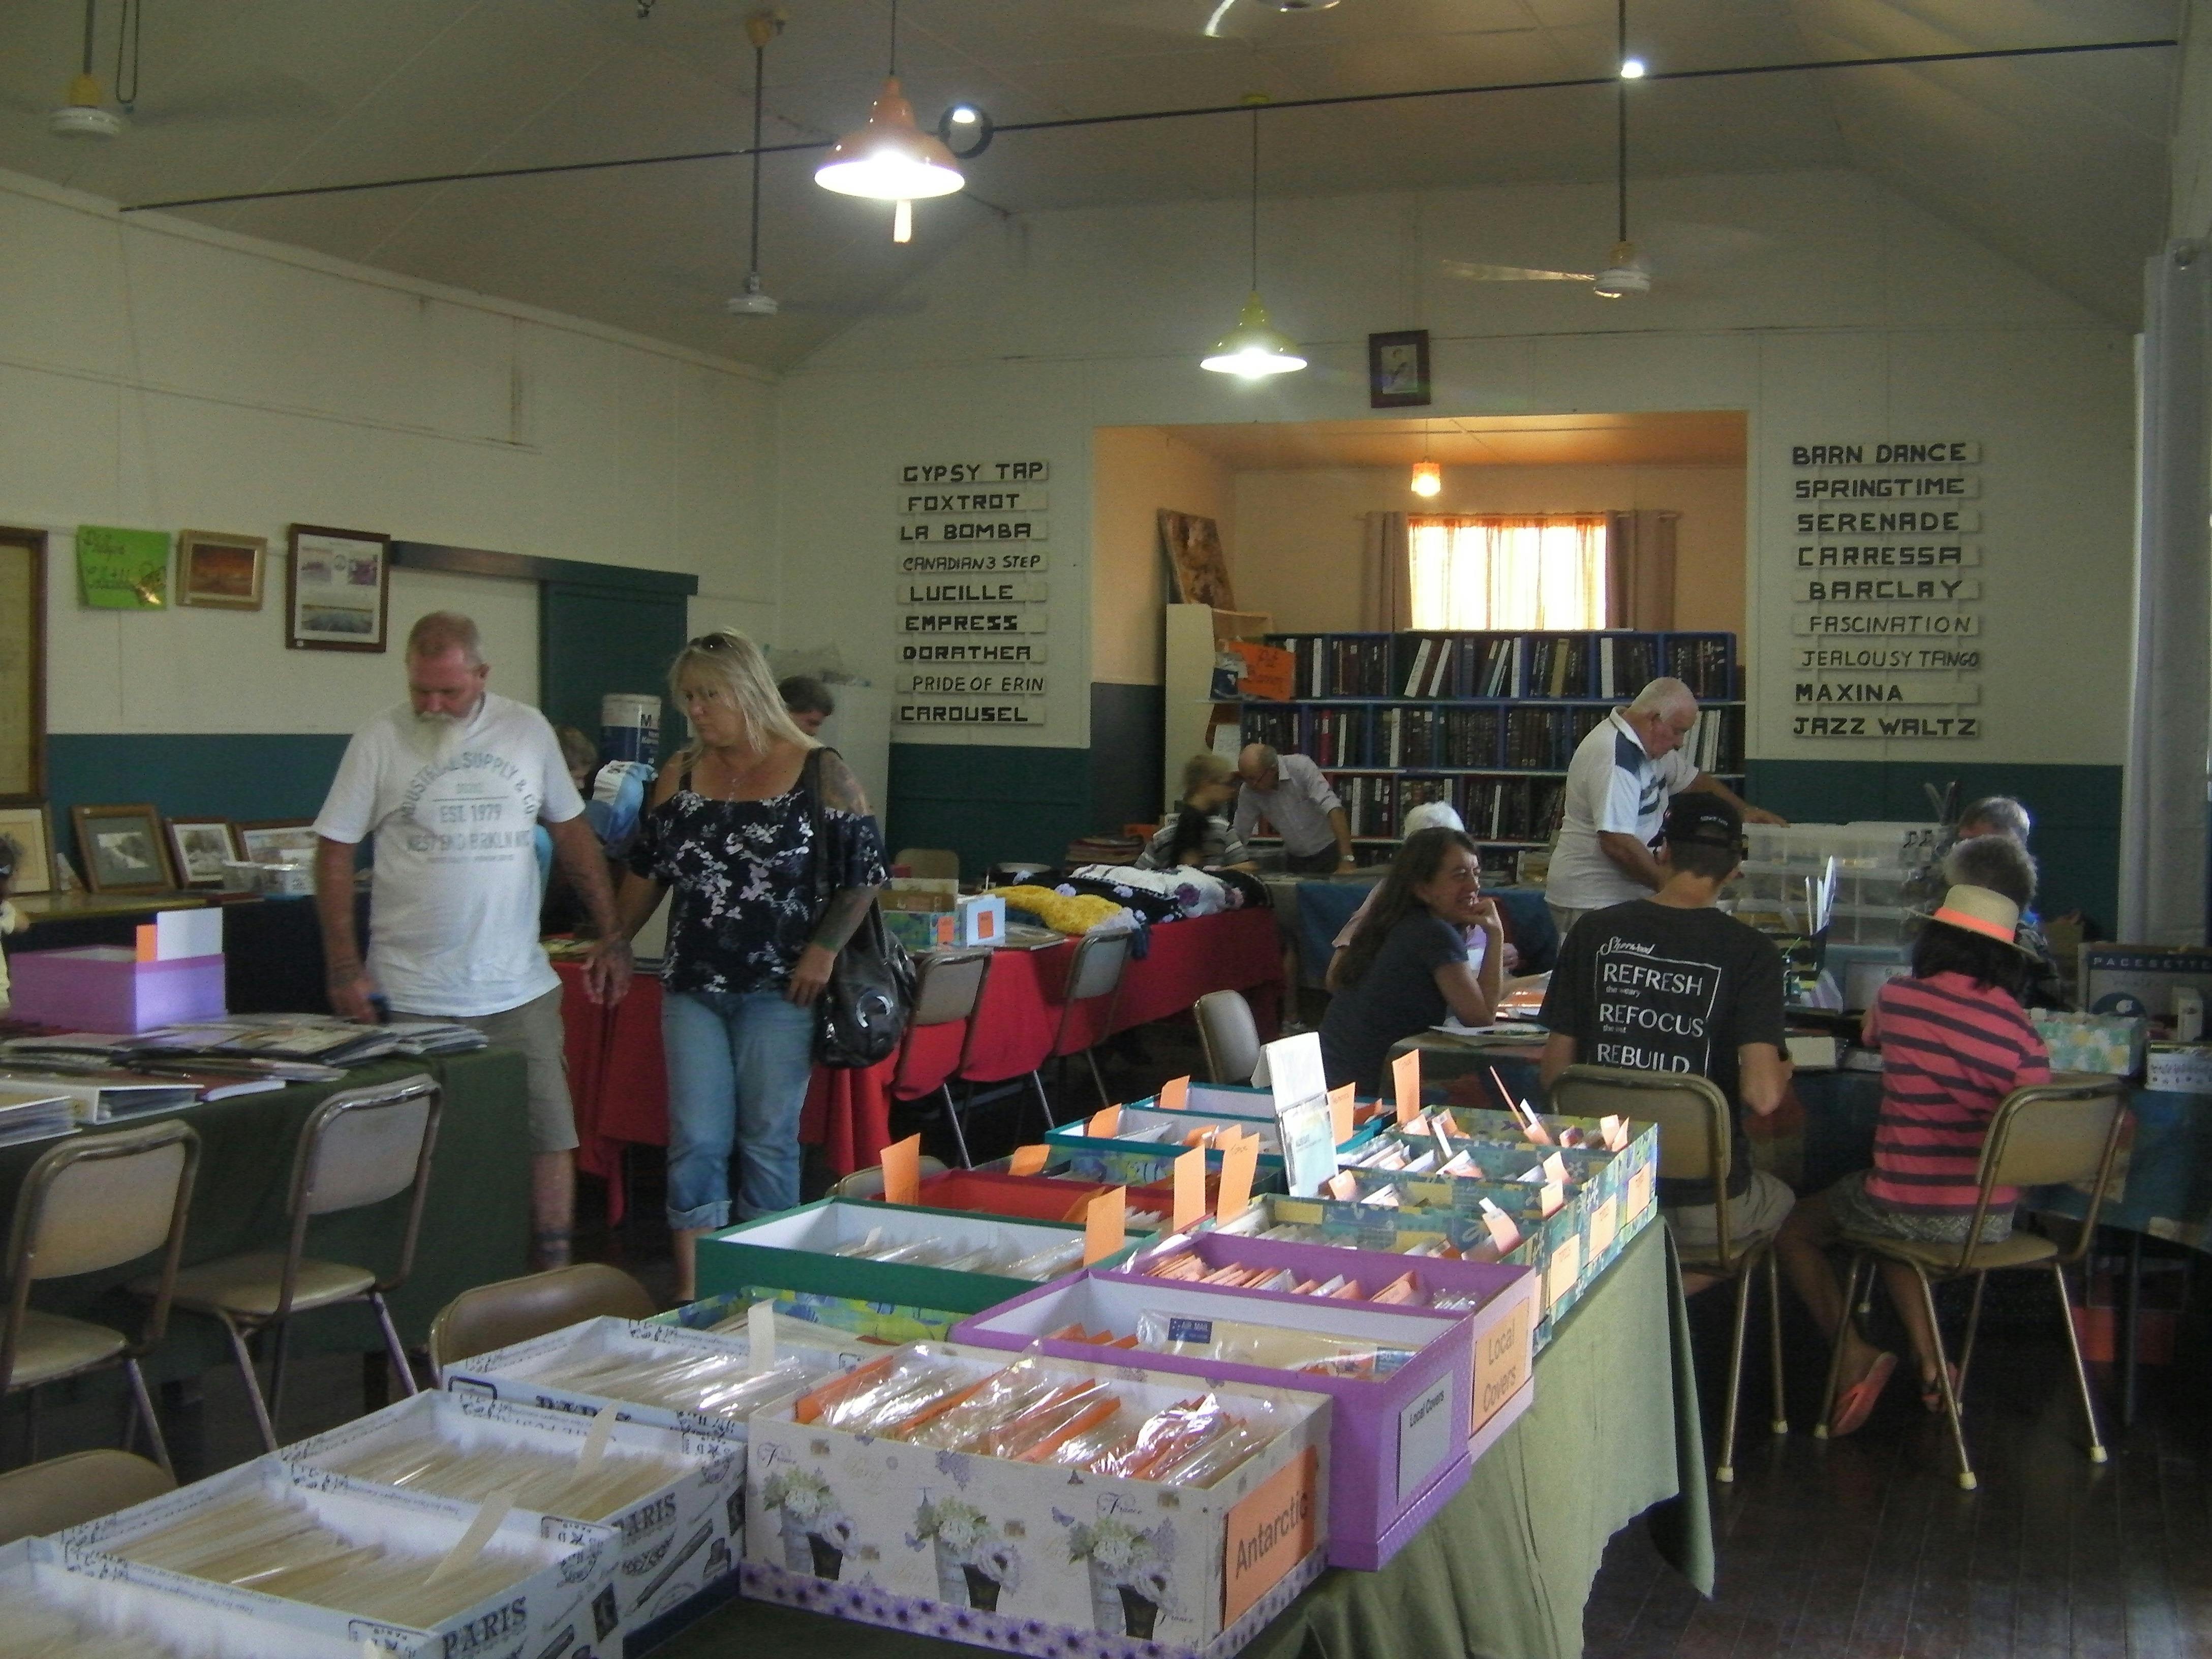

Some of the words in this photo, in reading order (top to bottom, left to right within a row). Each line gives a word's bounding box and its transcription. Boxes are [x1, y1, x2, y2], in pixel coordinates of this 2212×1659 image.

[1792, 445, 1863, 465] BARN
[1876, 443, 1966, 463] DANCE
[903, 464, 980, 482] GYPSY
[995, 462, 1043, 479] TAP
[1795, 478, 1964, 499] SPRINGTIME
[908, 493, 1020, 511] FOXTROT
[900, 525, 929, 541] LA
[944, 523, 1031, 540] BOMBA
[1798, 512, 1959, 532] SERENADE
[903, 556, 984, 571] CANADIAN
[1002, 554, 1041, 568] STEP
[1798, 546, 1962, 566] CARRESSA
[910, 585, 1013, 601] LUCILLE
[1809, 580, 1962, 600] BARCLAY
[905, 615, 1018, 631] EMPRESS
[1809, 616, 1970, 633] FASCINATION
[903, 646, 1031, 661] DORATHEA
[1802, 650, 1913, 667] JEALOUSY
[1919, 651, 1980, 668] TANGO
[913, 675, 966, 692] PRIDE
[970, 677, 992, 691] OF
[1002, 677, 1043, 691] ERIN
[1795, 684, 1903, 702] MAXINA
[901, 705, 1028, 722] CAROUSEL
[1793, 717, 1865, 735] JAZZ
[1879, 717, 1976, 736] WALTZ
[1603, 963, 1703, 996] REFRESH
[1600, 1003, 1704, 1037] REFOCUS
[1597, 1043, 1691, 1074] REBUILD
[1489, 1318, 1515, 1365] Local
[1483, 1366, 1516, 1412] Covers
[1409, 1403, 1425, 1428] Local
[1235, 1491, 1308, 1580] Antarctic
[442, 1595, 527, 1659] PARIS
